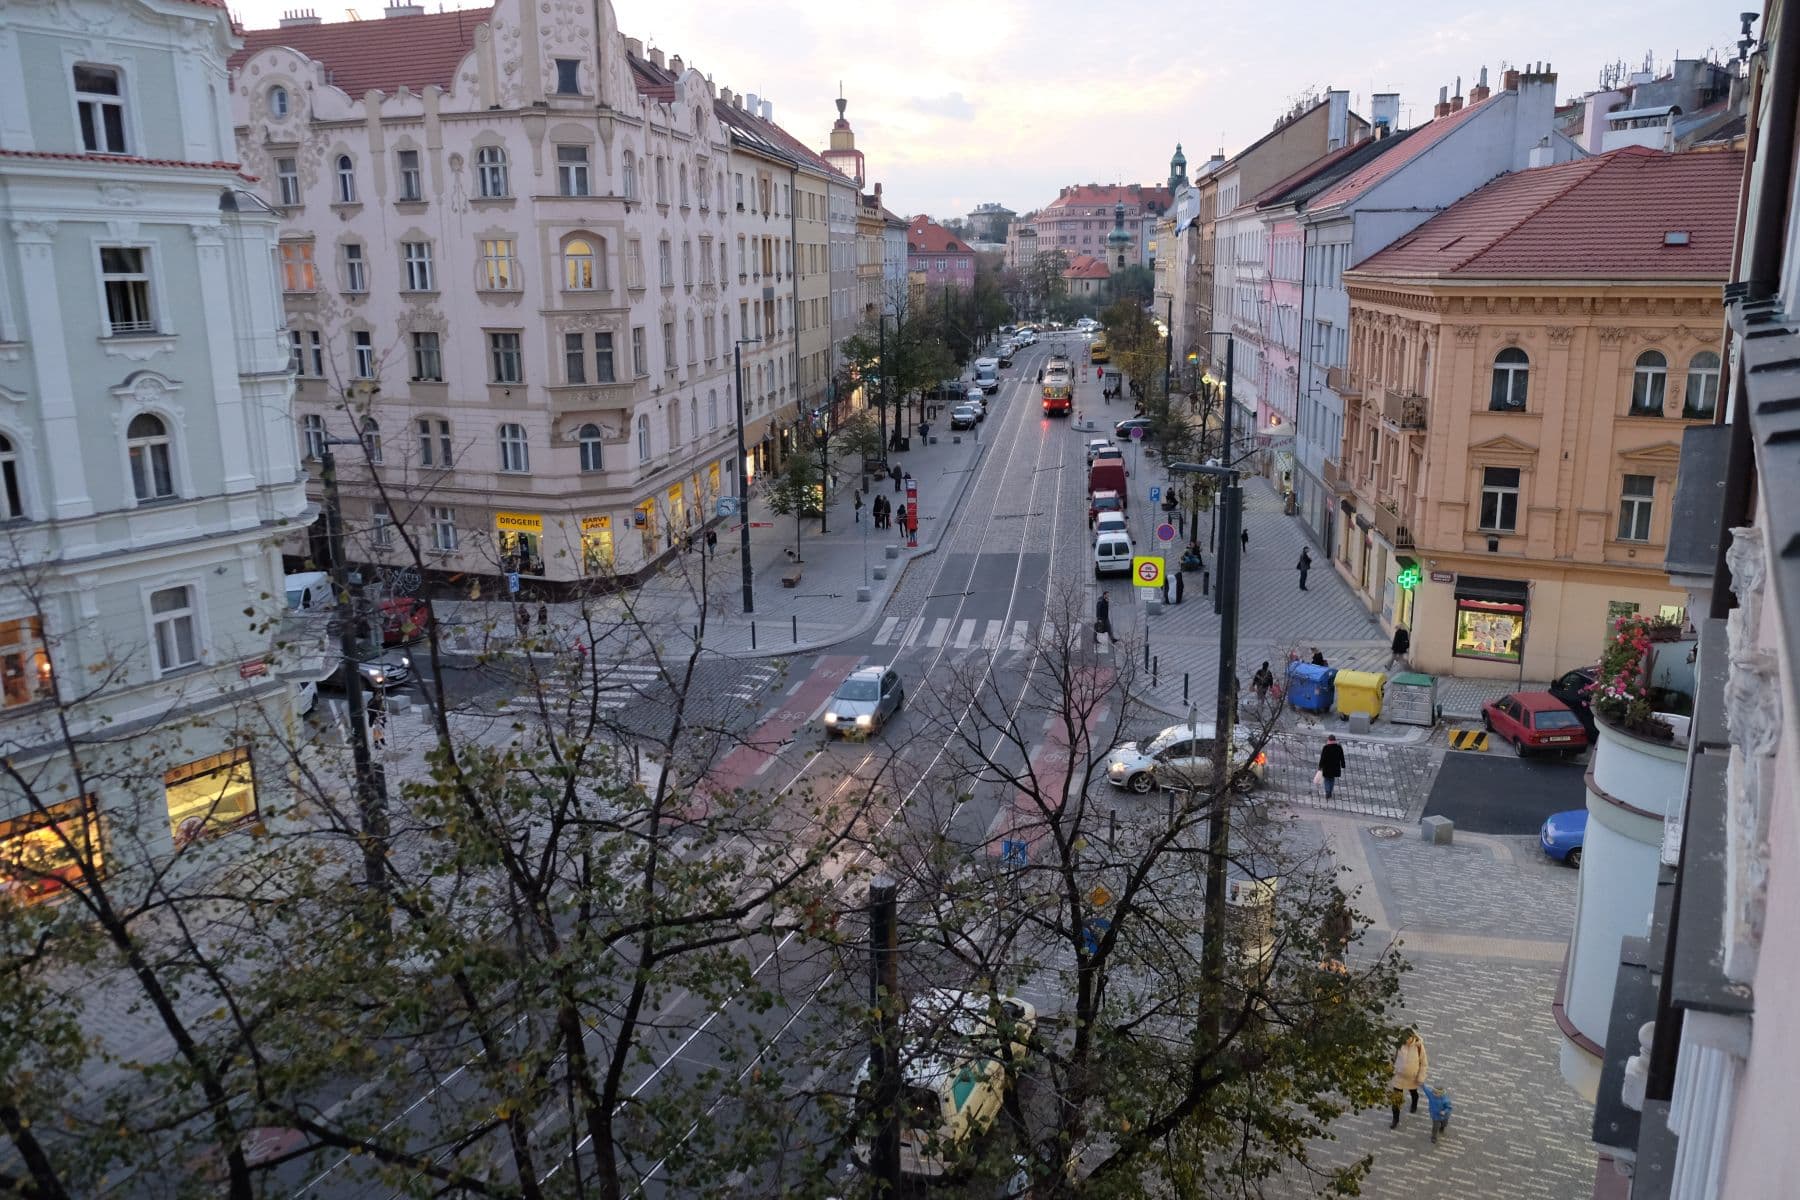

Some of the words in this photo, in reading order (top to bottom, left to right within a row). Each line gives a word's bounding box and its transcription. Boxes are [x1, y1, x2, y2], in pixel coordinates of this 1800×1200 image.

[1152, 488, 1159, 498] P
[500, 517, 541, 527] DROGERIE
[585, 522, 605, 530] LAKY
